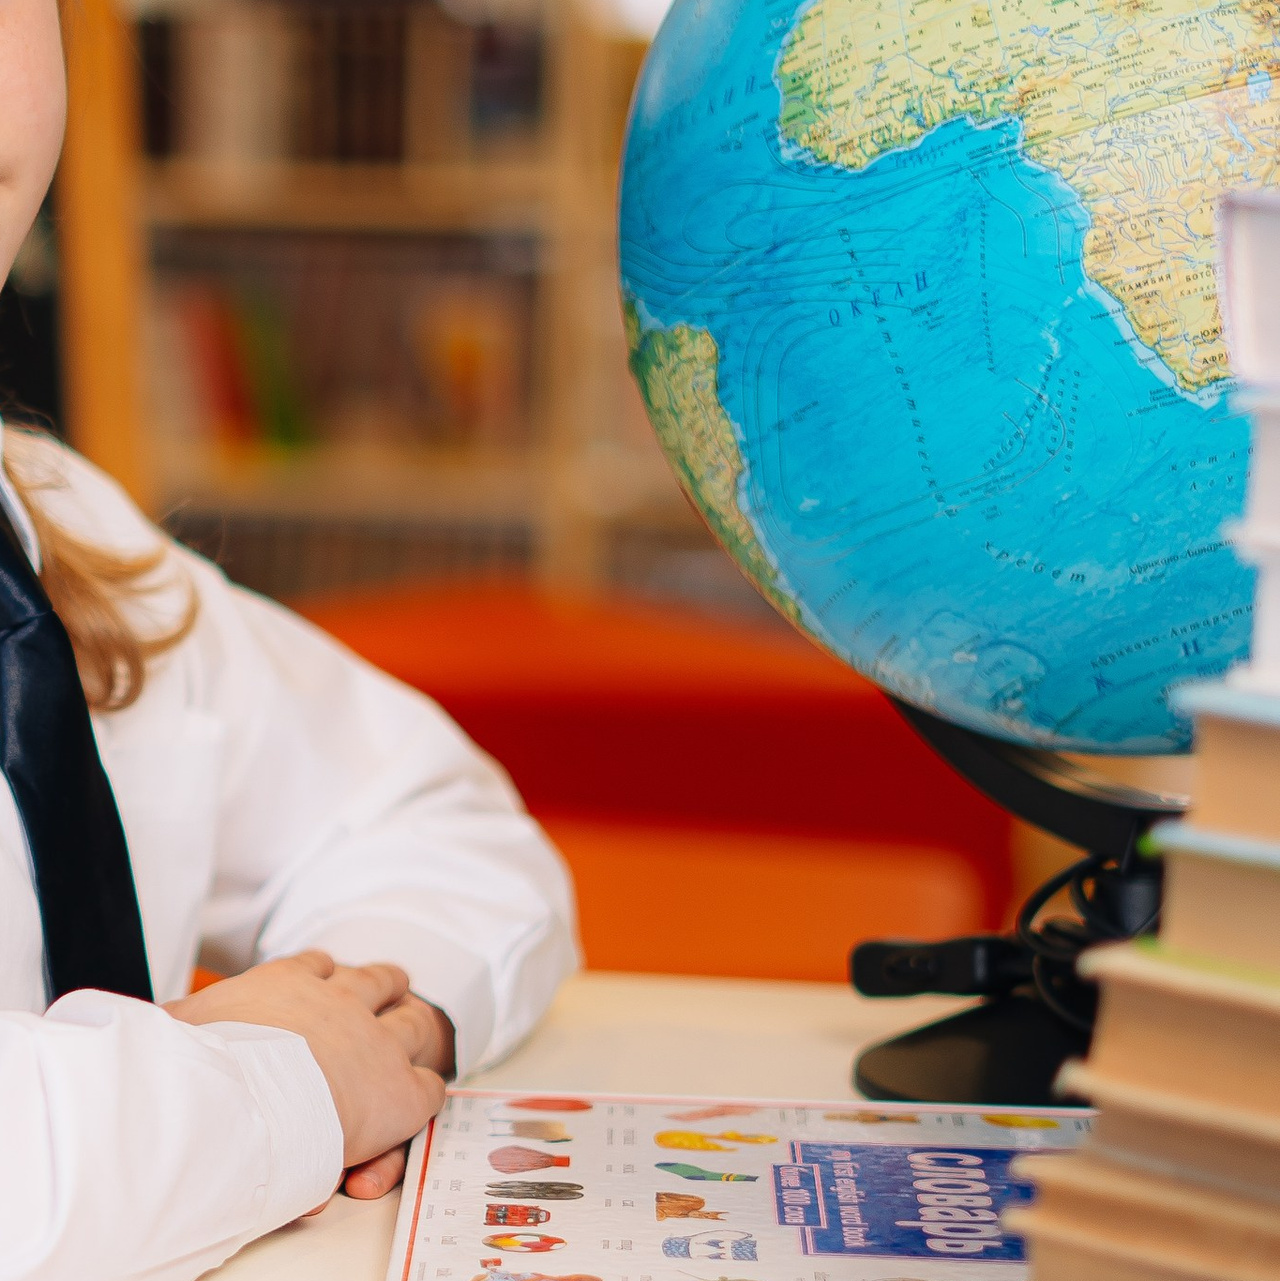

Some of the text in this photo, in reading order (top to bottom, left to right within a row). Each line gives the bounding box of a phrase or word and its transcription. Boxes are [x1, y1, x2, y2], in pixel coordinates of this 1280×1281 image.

[1119, 273, 1172, 293] НАМИБИЯ
[828, 271, 929, 327] ОКЕАН
[984, 540, 1086, 583] хребет
[832, 1162, 861, 1178] first
[829, 1178, 868, 1204] english
[894, 1151, 1003, 1254] словарь
[839, 1205, 869, 1226] word
[842, 1226, 876, 1248] book
